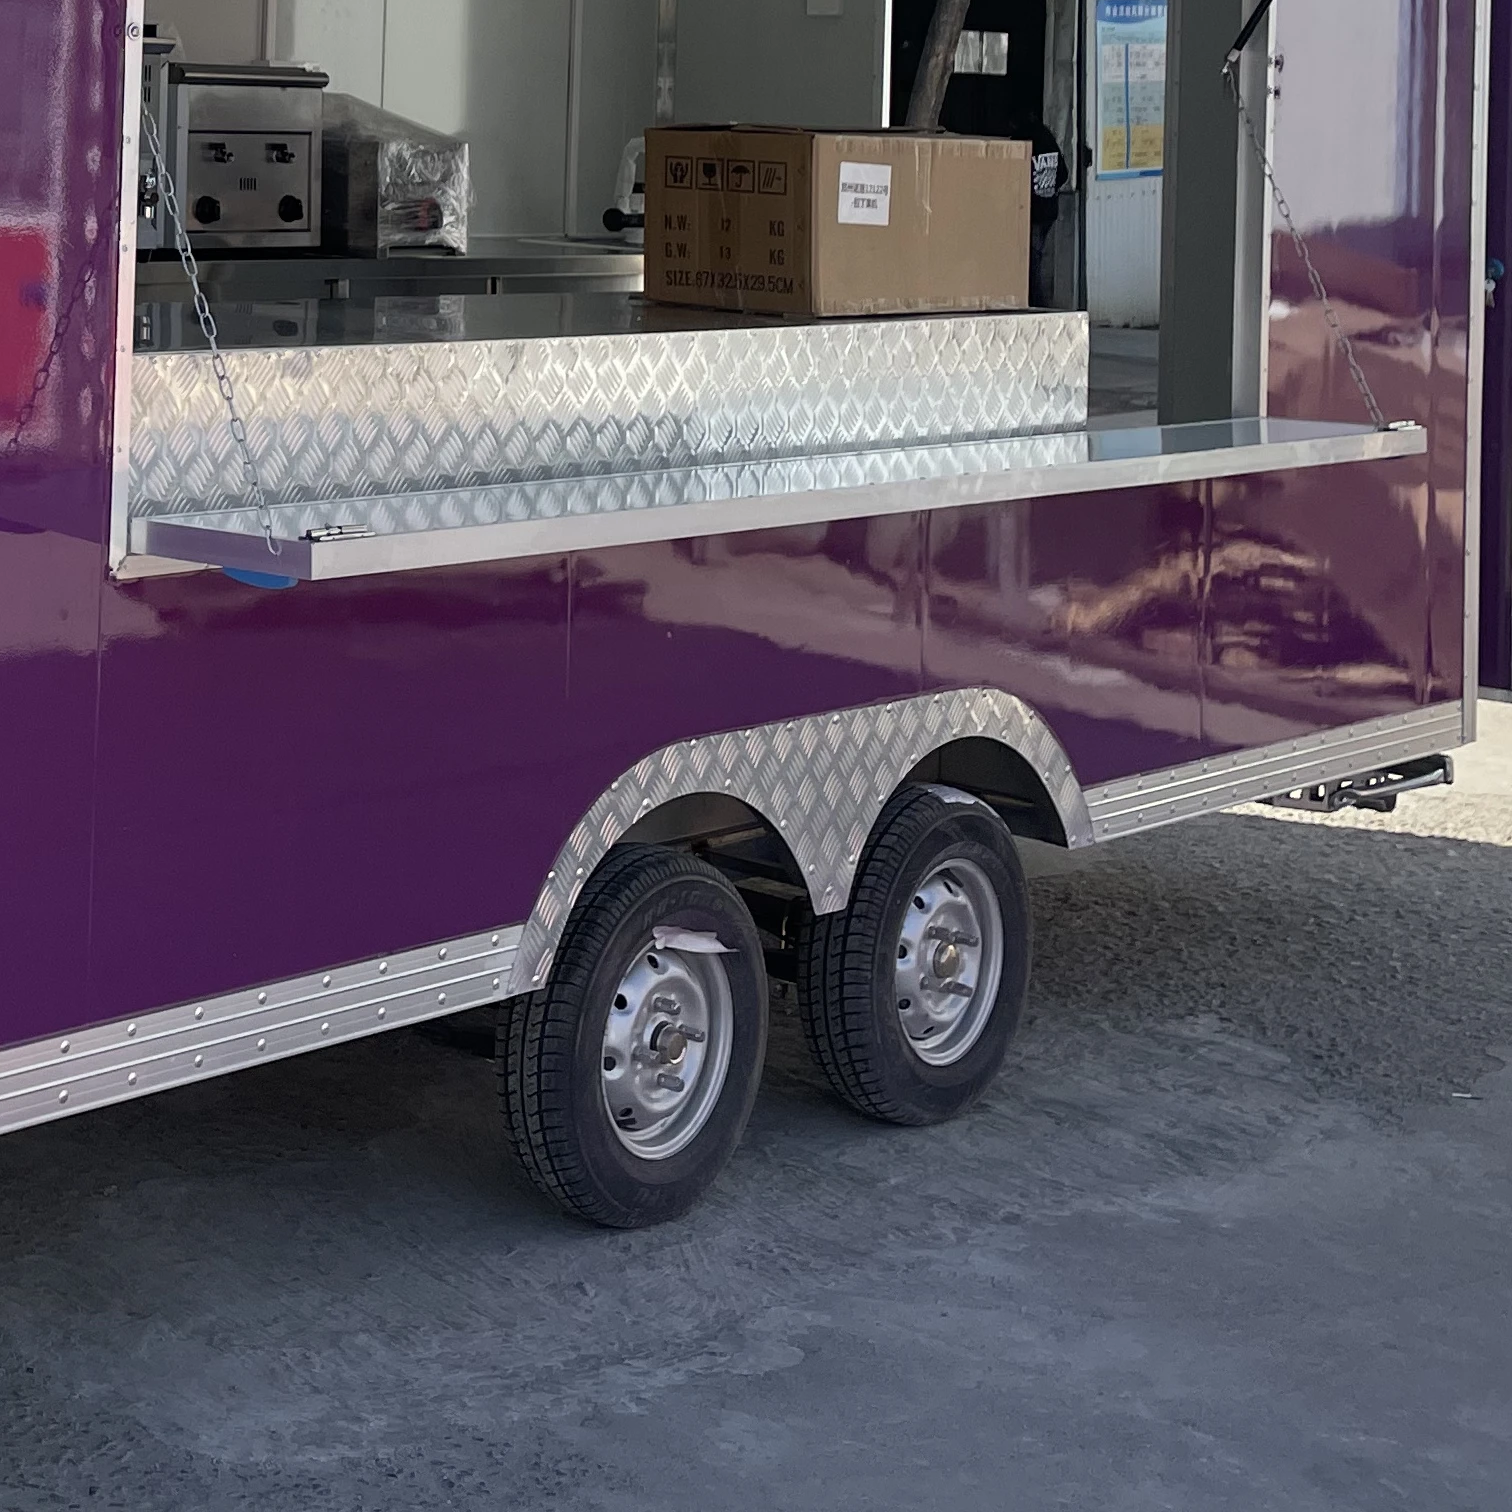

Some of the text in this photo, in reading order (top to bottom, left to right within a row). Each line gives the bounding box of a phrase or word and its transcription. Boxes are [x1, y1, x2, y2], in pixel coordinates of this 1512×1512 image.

[769, 220, 786, 237] KG
[719, 245, 732, 261] 13
[769, 248, 786, 266] KG
